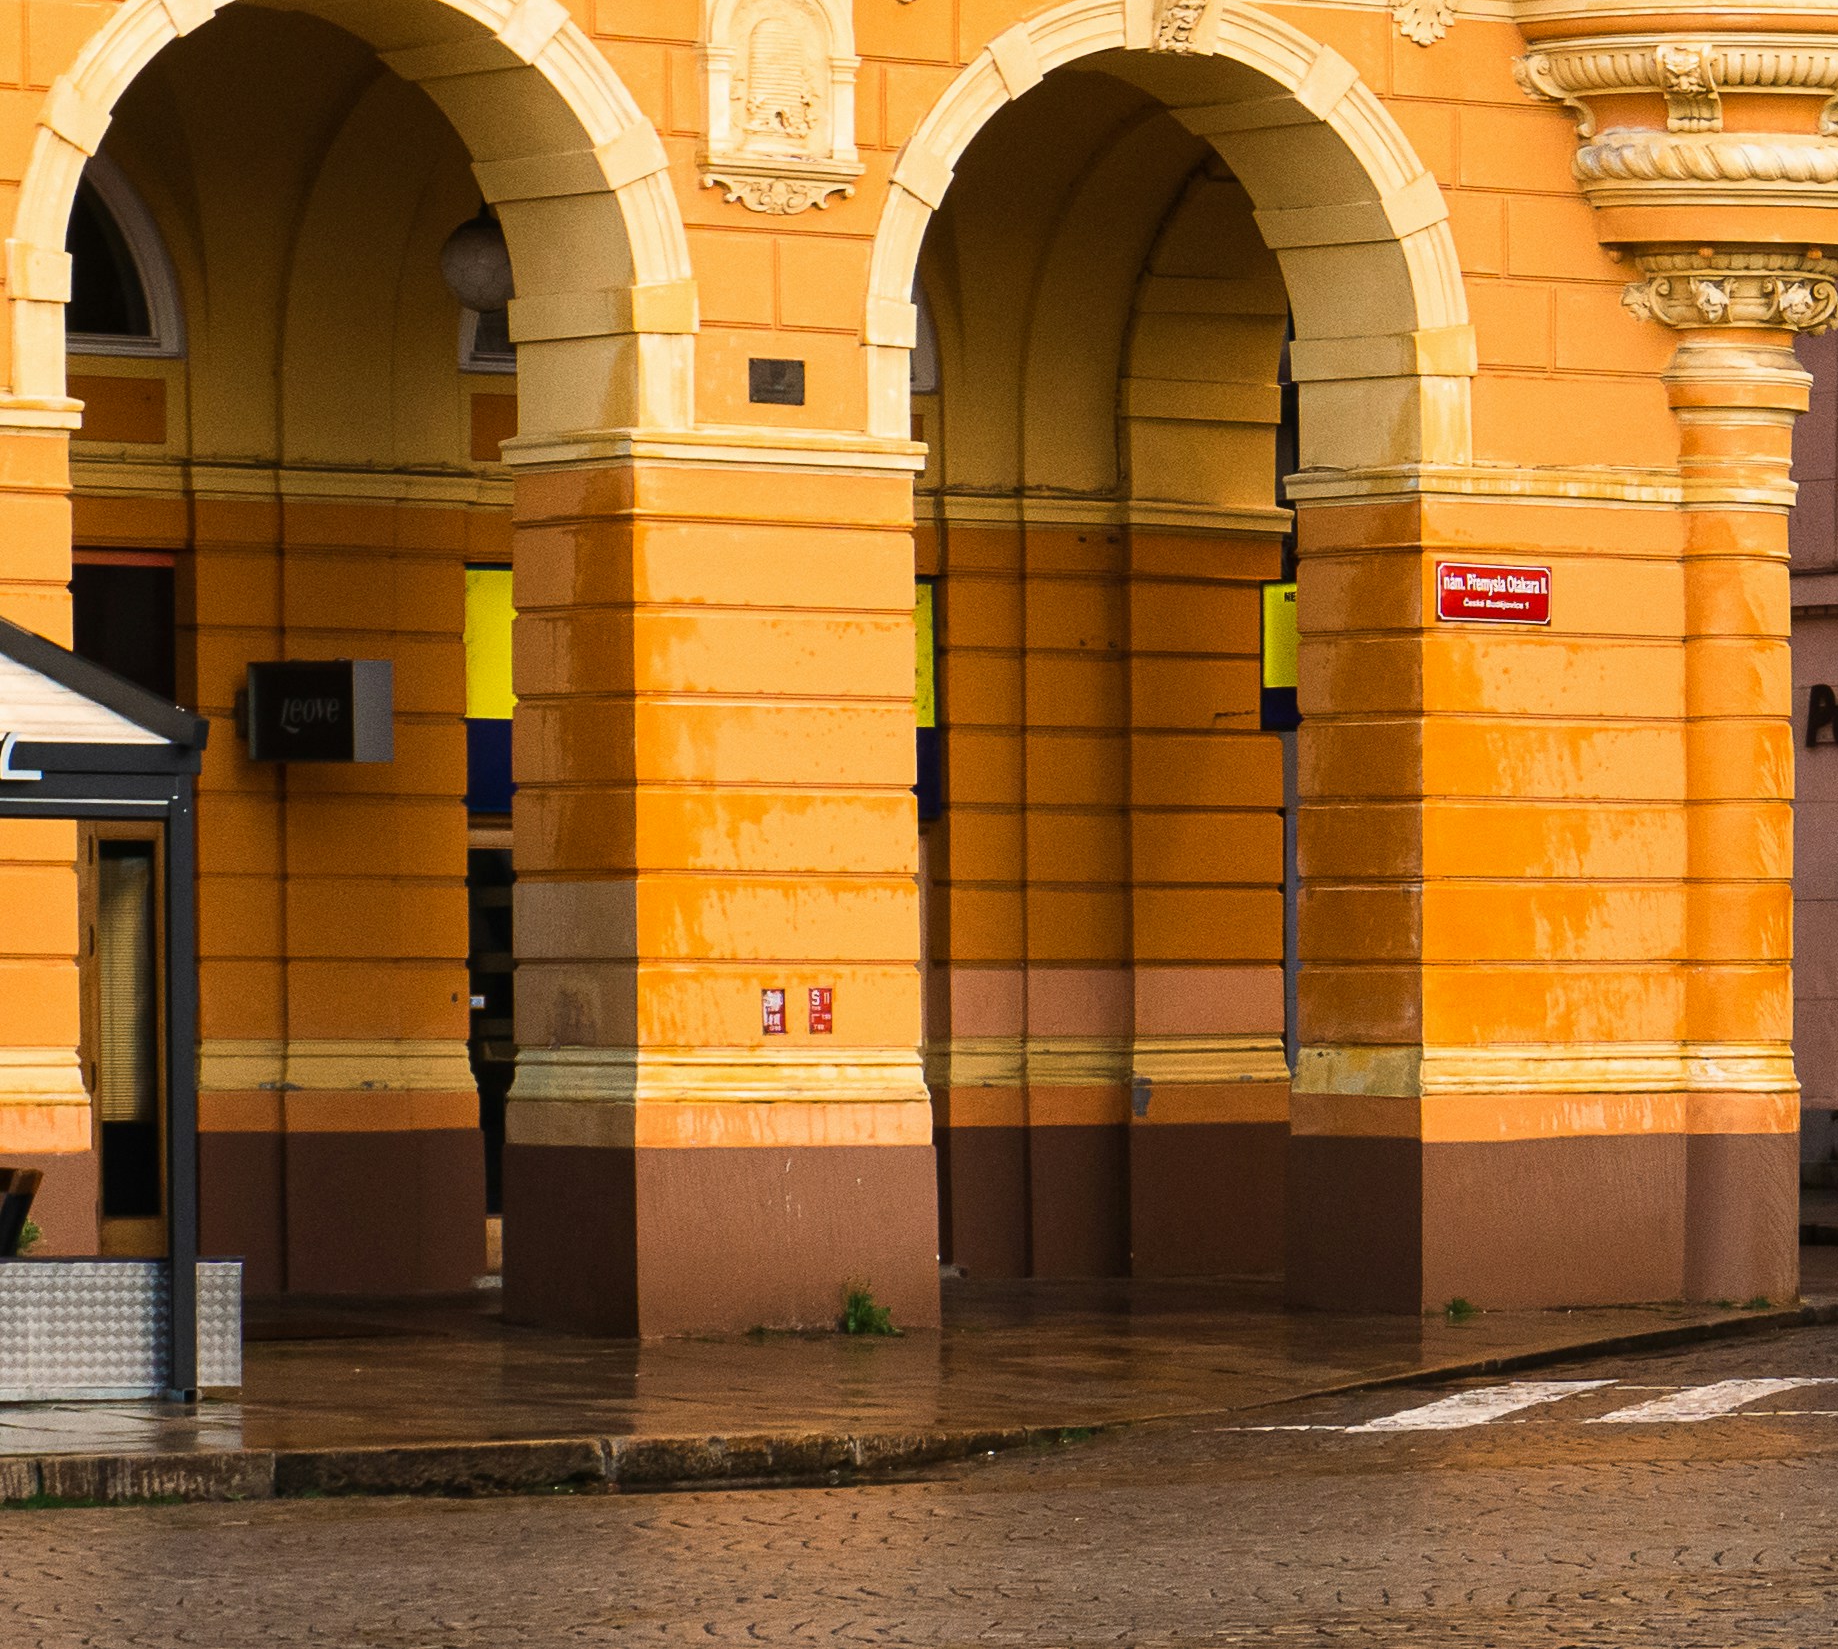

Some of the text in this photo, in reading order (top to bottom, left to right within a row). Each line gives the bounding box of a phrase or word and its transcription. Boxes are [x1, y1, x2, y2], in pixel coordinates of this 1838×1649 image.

[1443, 573, 1465, 590] nám.
[1467, 573, 1506, 596] Přemysla
[1507, 576, 1540, 594] Otakara
